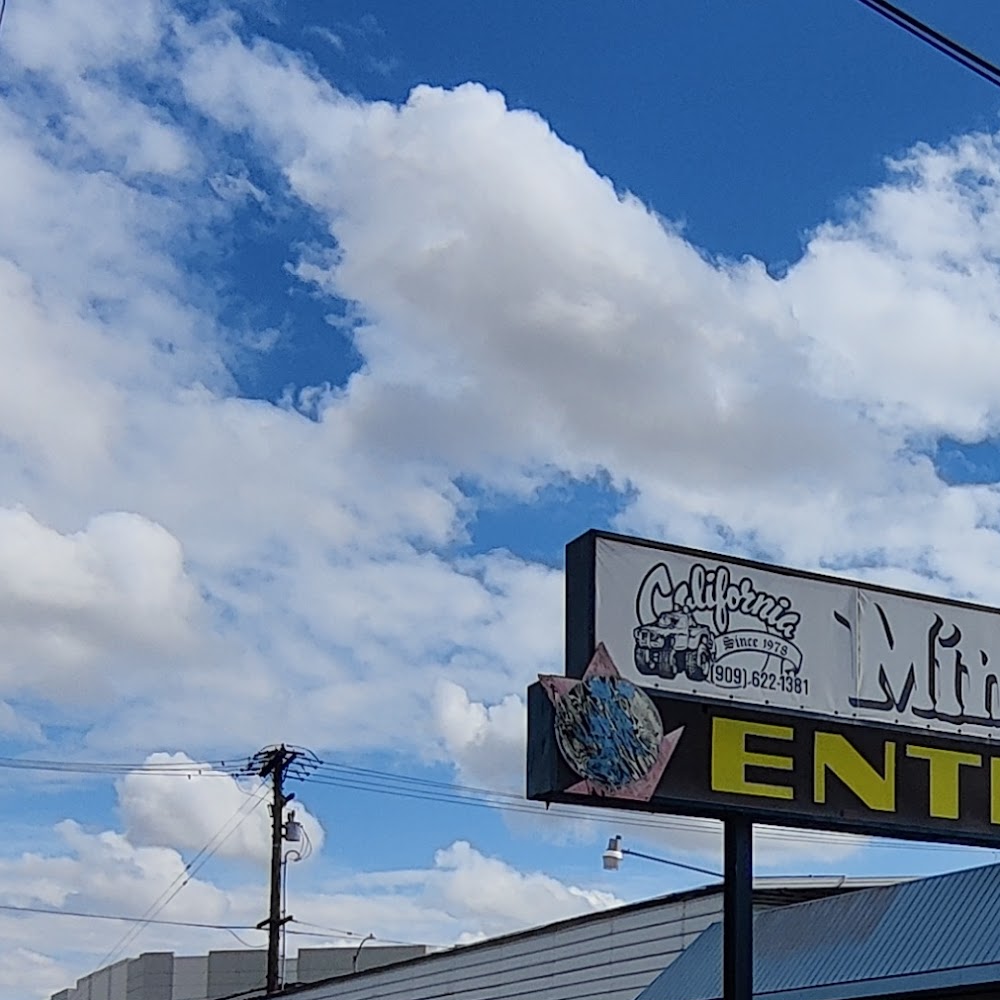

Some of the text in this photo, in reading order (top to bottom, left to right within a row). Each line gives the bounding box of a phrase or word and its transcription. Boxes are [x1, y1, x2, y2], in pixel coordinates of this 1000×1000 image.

[636, 562, 801, 640] California
[723, 635, 788, 656] Since 1978
[751, 670, 809, 695] 622-1381
